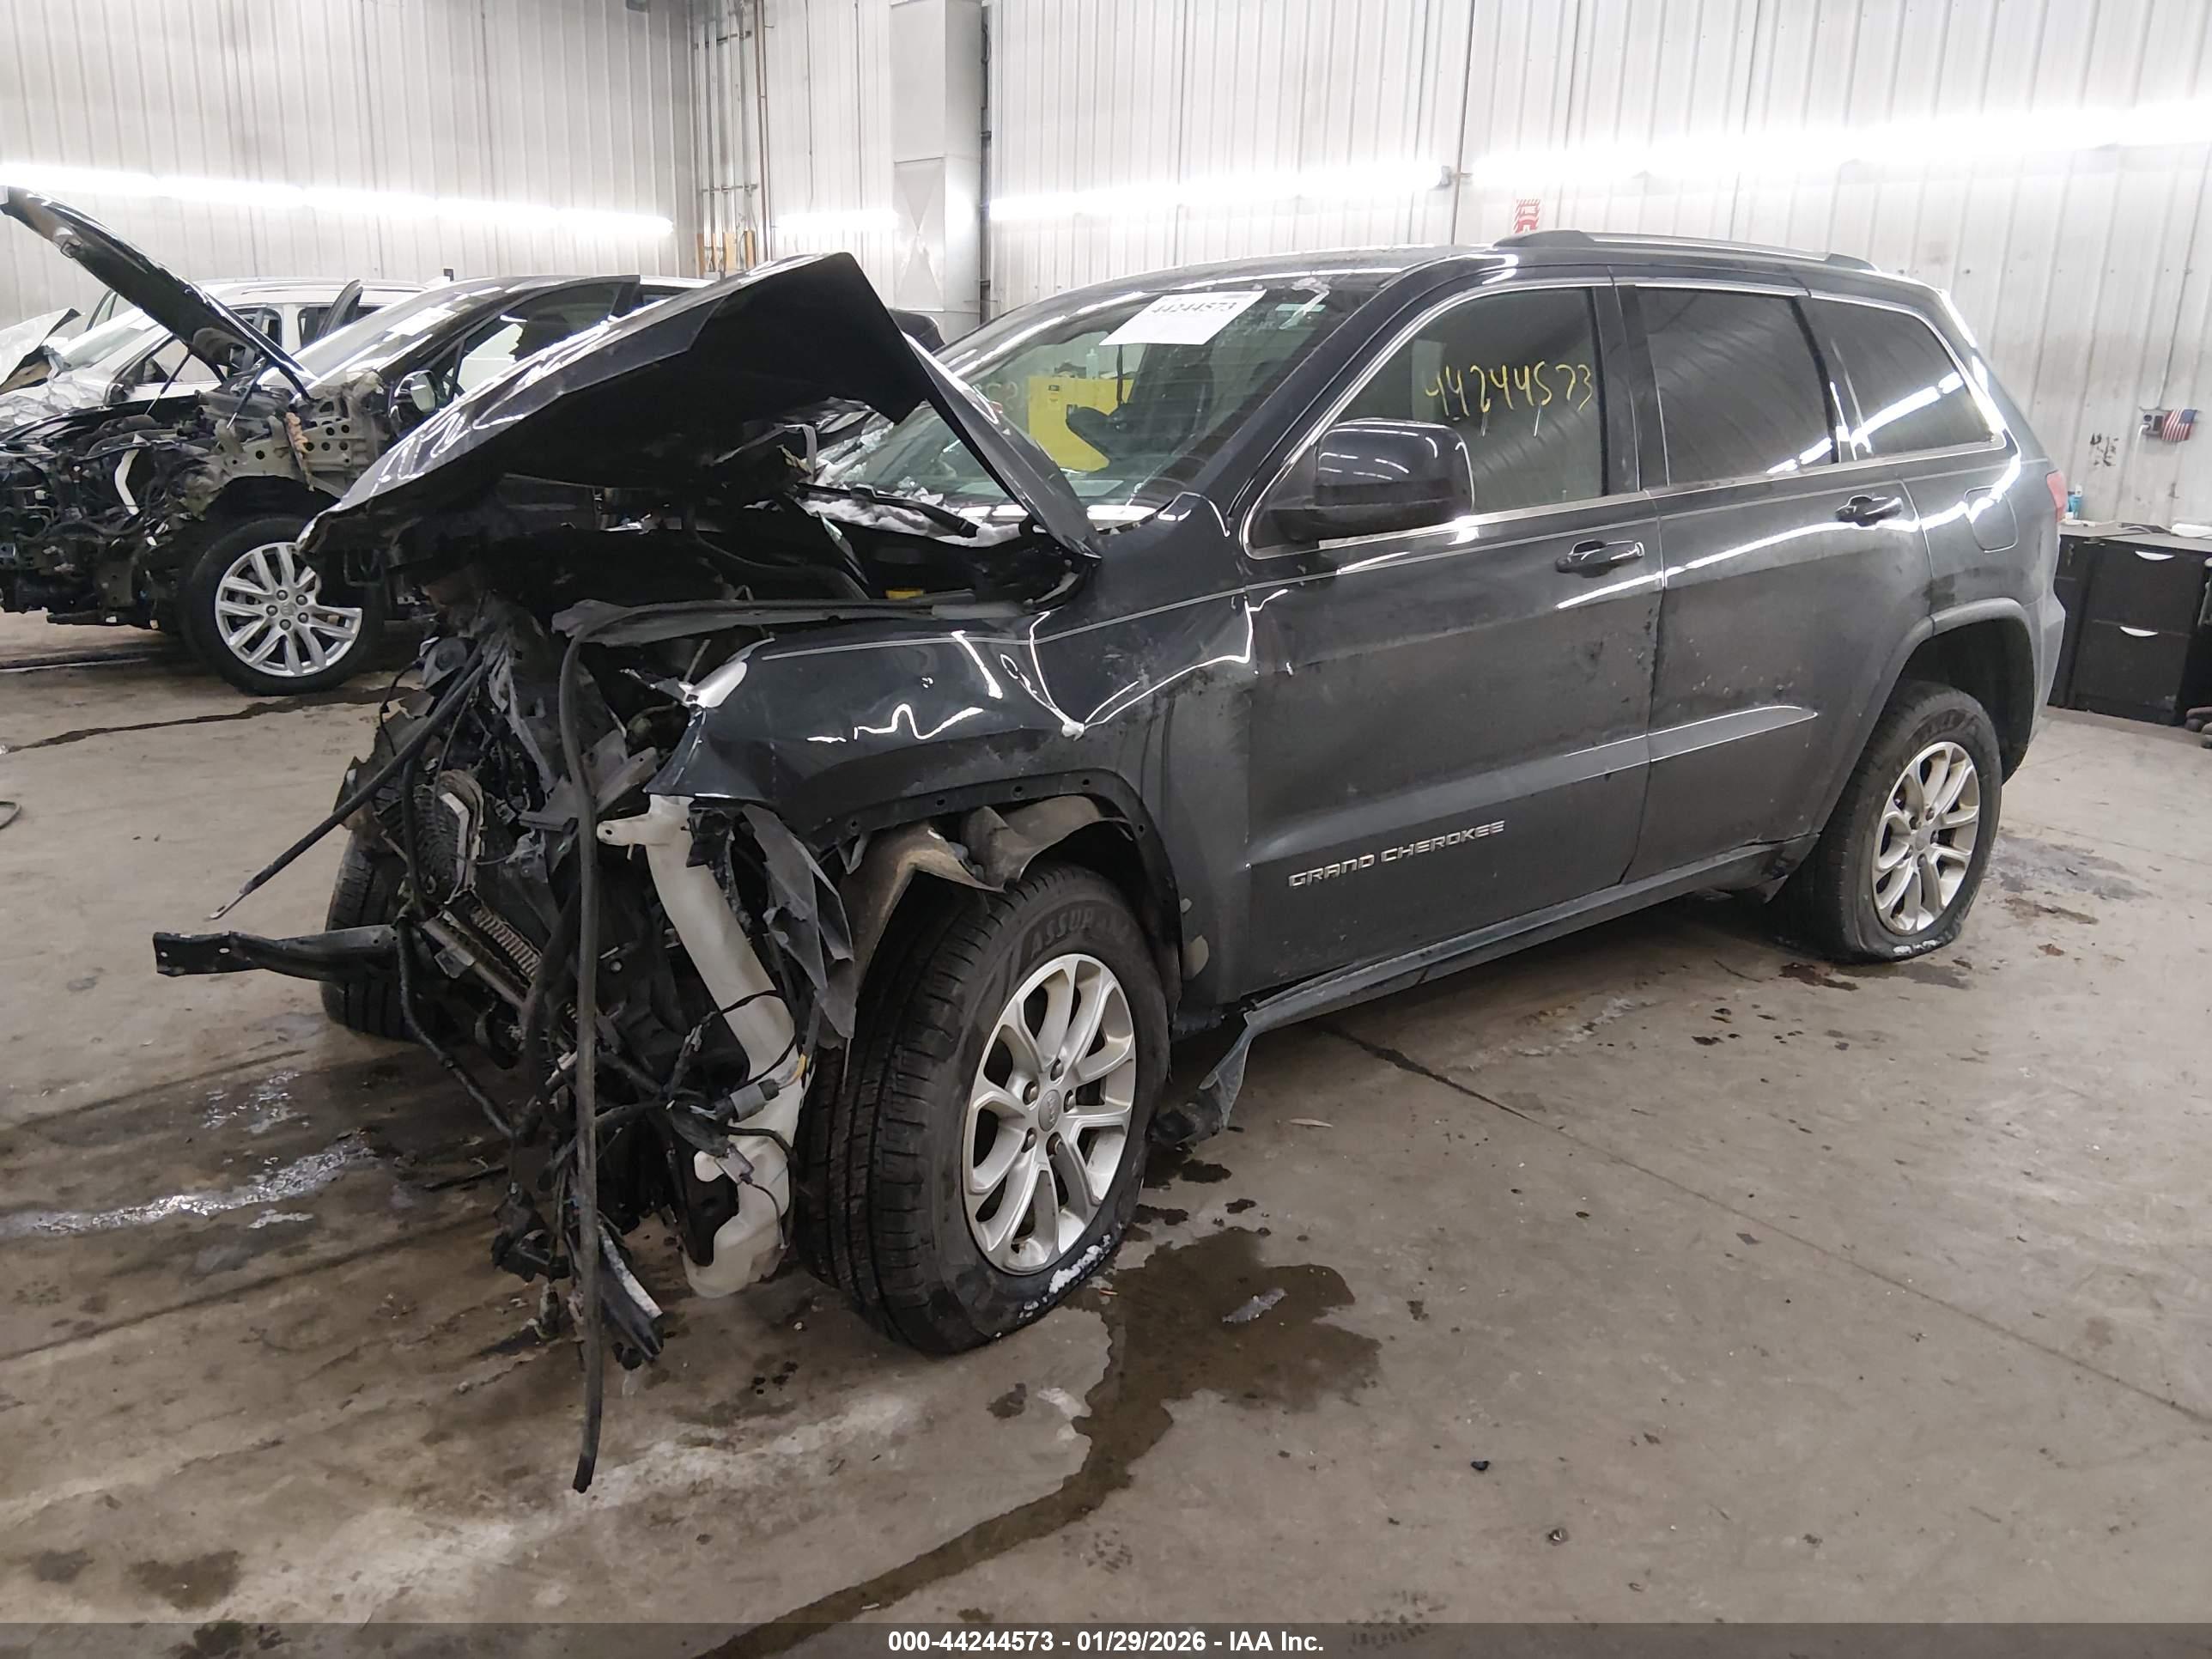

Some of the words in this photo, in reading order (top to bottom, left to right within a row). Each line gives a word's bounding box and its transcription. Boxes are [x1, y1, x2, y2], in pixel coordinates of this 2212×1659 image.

[1425, 361, 1593, 416] 44244573
[1288, 854, 1375, 887] GRAND
[1380, 820, 1505, 863] CHEROKEE
